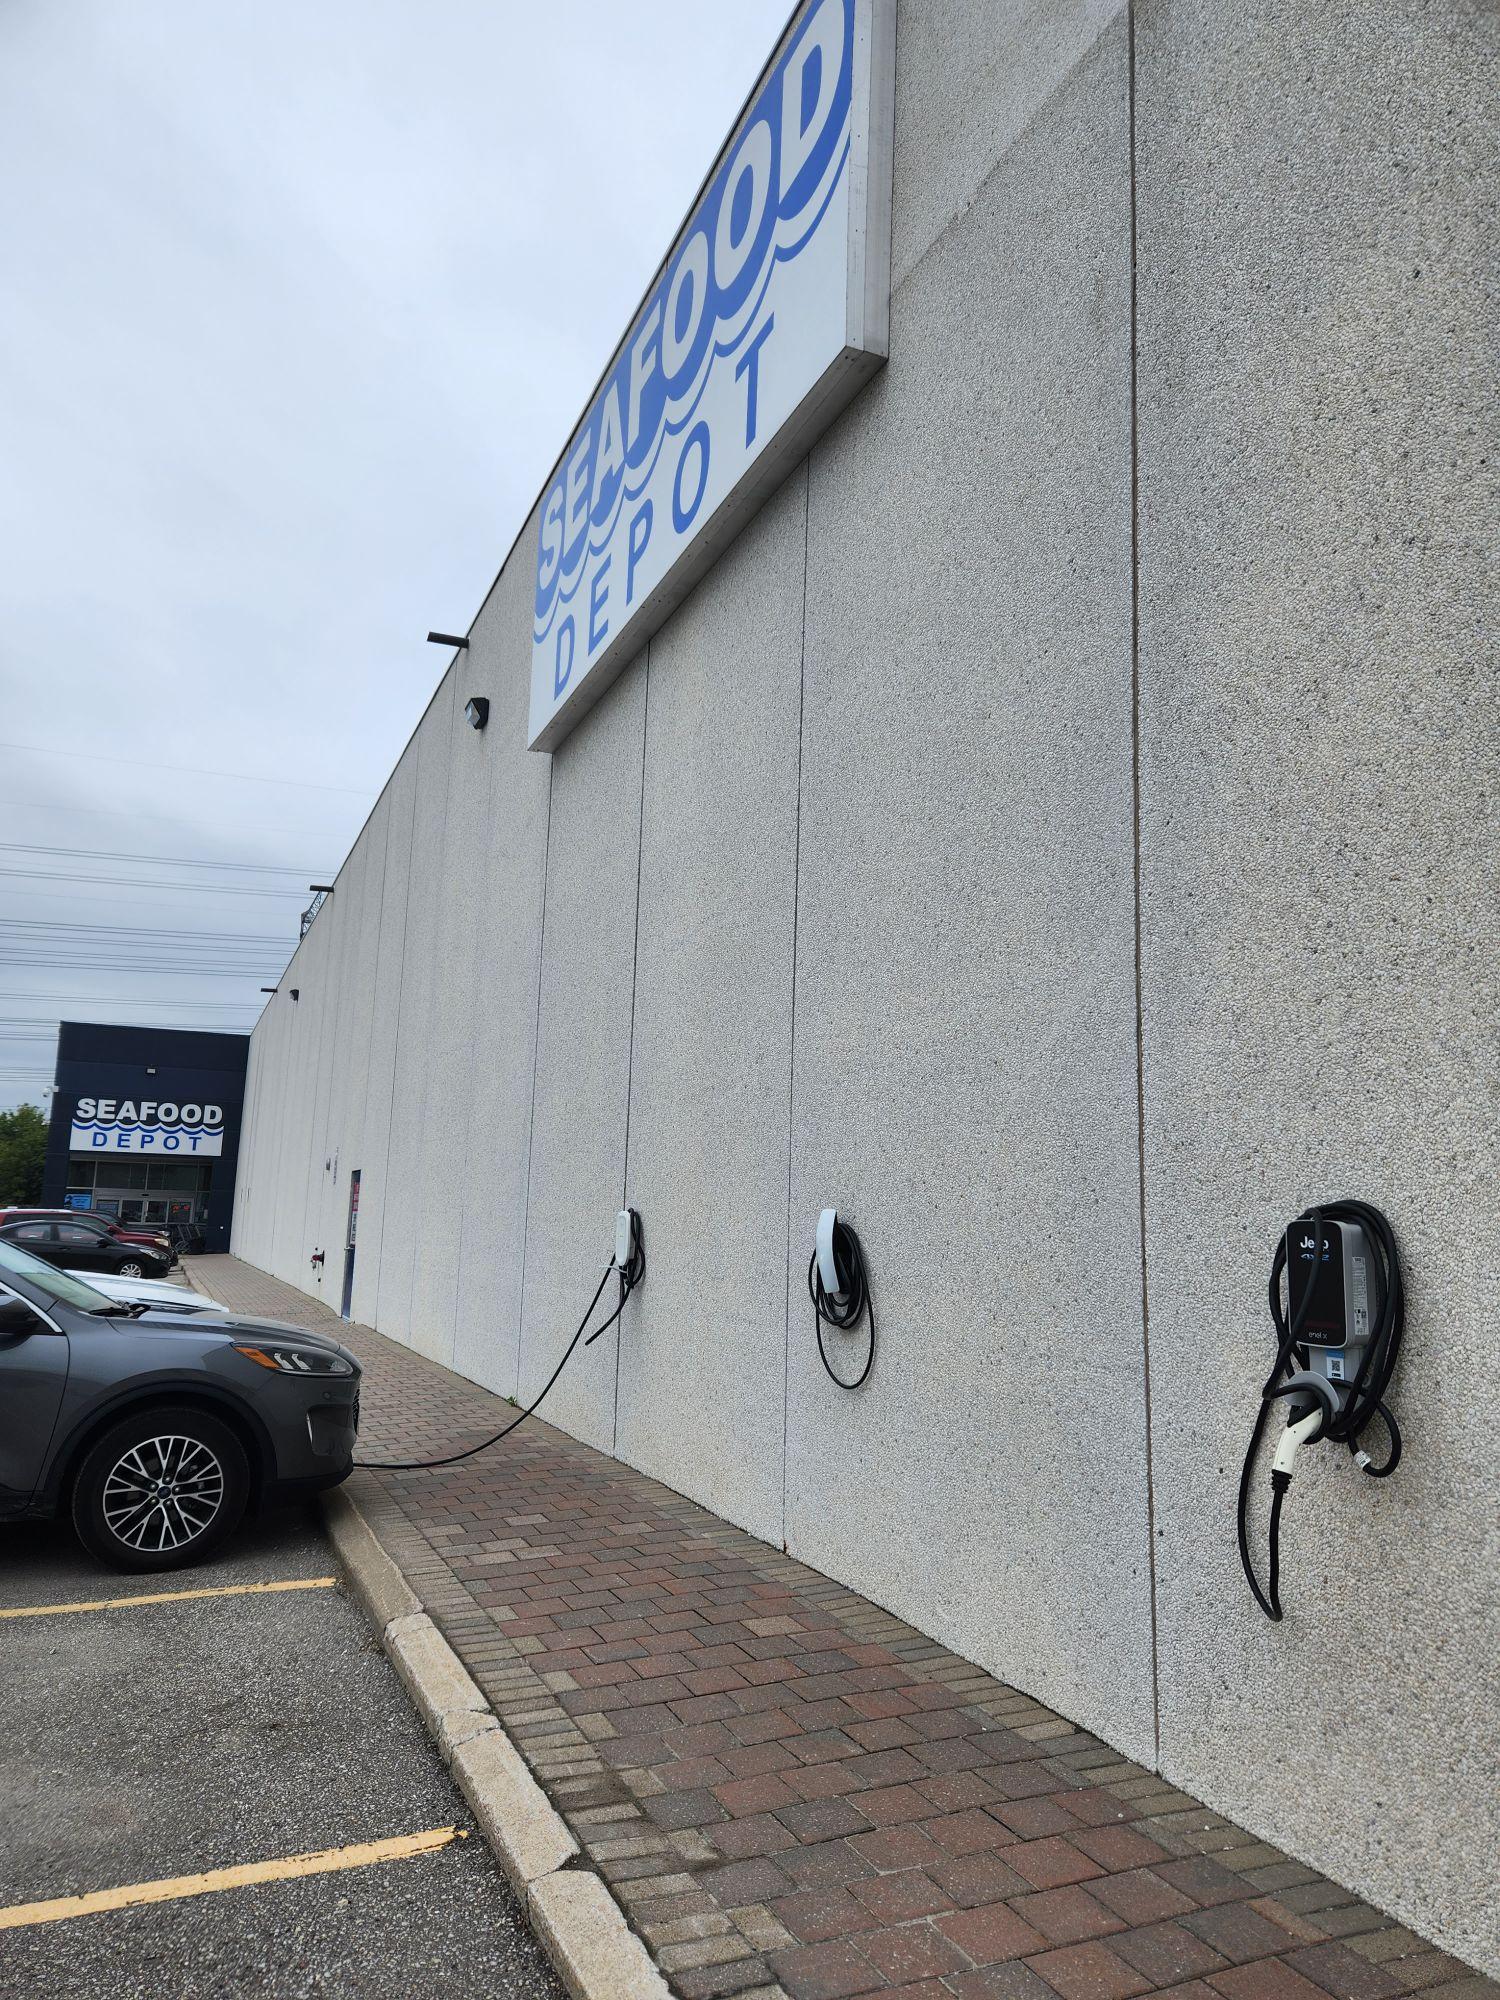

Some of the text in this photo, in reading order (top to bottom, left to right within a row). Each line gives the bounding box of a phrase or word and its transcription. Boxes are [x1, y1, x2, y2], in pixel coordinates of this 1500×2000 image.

[538, 0, 845, 591] SEAFOOD
[554, 312, 775, 702] DEPOT
[76, 1098, 223, 1125] SEAFOOD
[92, 1131, 202, 1151] DEPOT
[1300, 1235, 1329, 1251] Jep
